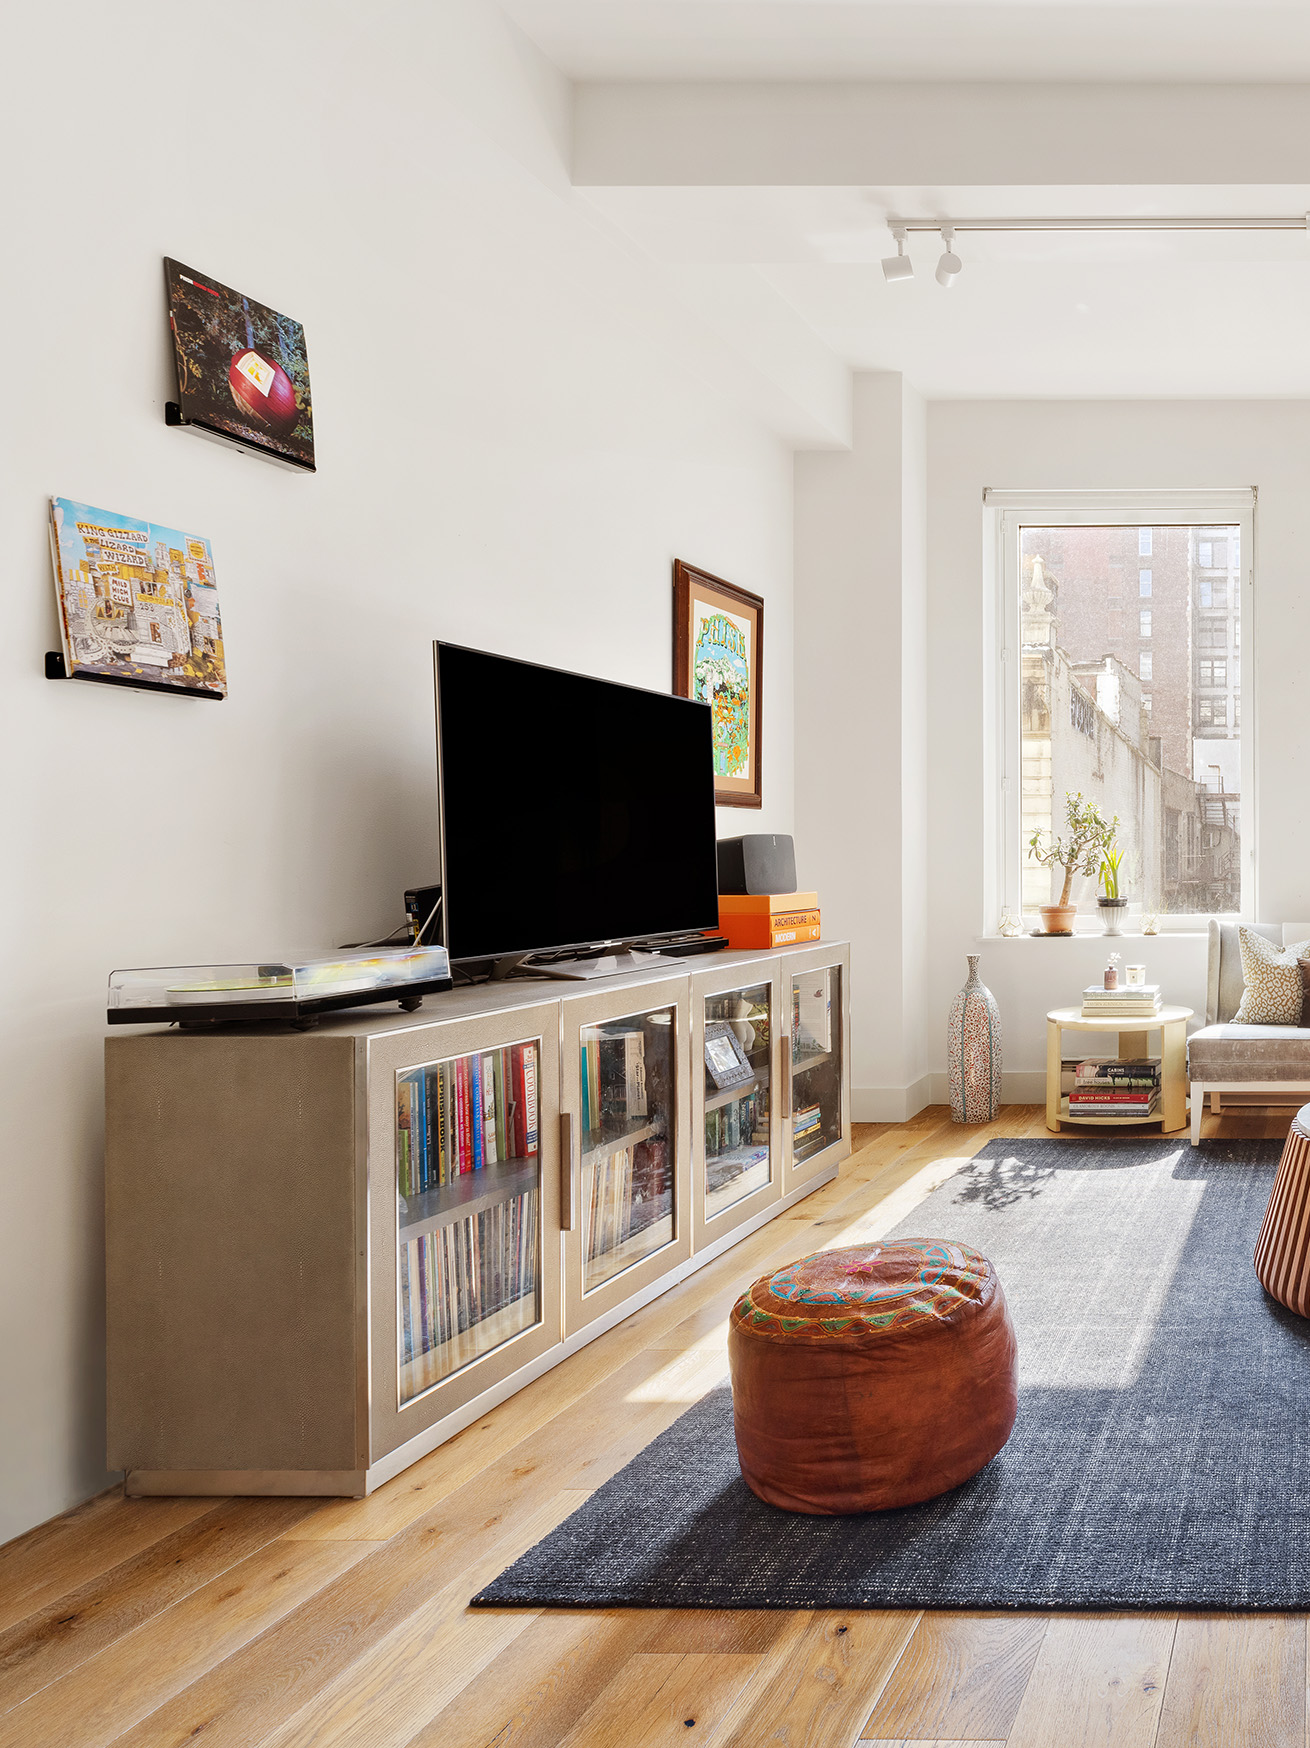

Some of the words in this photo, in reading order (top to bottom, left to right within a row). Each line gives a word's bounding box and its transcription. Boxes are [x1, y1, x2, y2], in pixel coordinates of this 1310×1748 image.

[77, 523, 105, 536] KING
[107, 528, 149, 543] GIZZARD
[100, 538, 135, 554] LIZARD
[104, 551, 144, 565] WIZARD
[98, 563, 116, 573] WITH
[111, 579, 128, 589] MILD
[113, 594, 130, 604] CLUB
[696, 616, 747, 662] PHISH
[774, 914, 807, 927] ARCHITECTURE
[775, 931, 797, 944] MODERN
[526, 1068, 537, 1130] COOKBOOK
